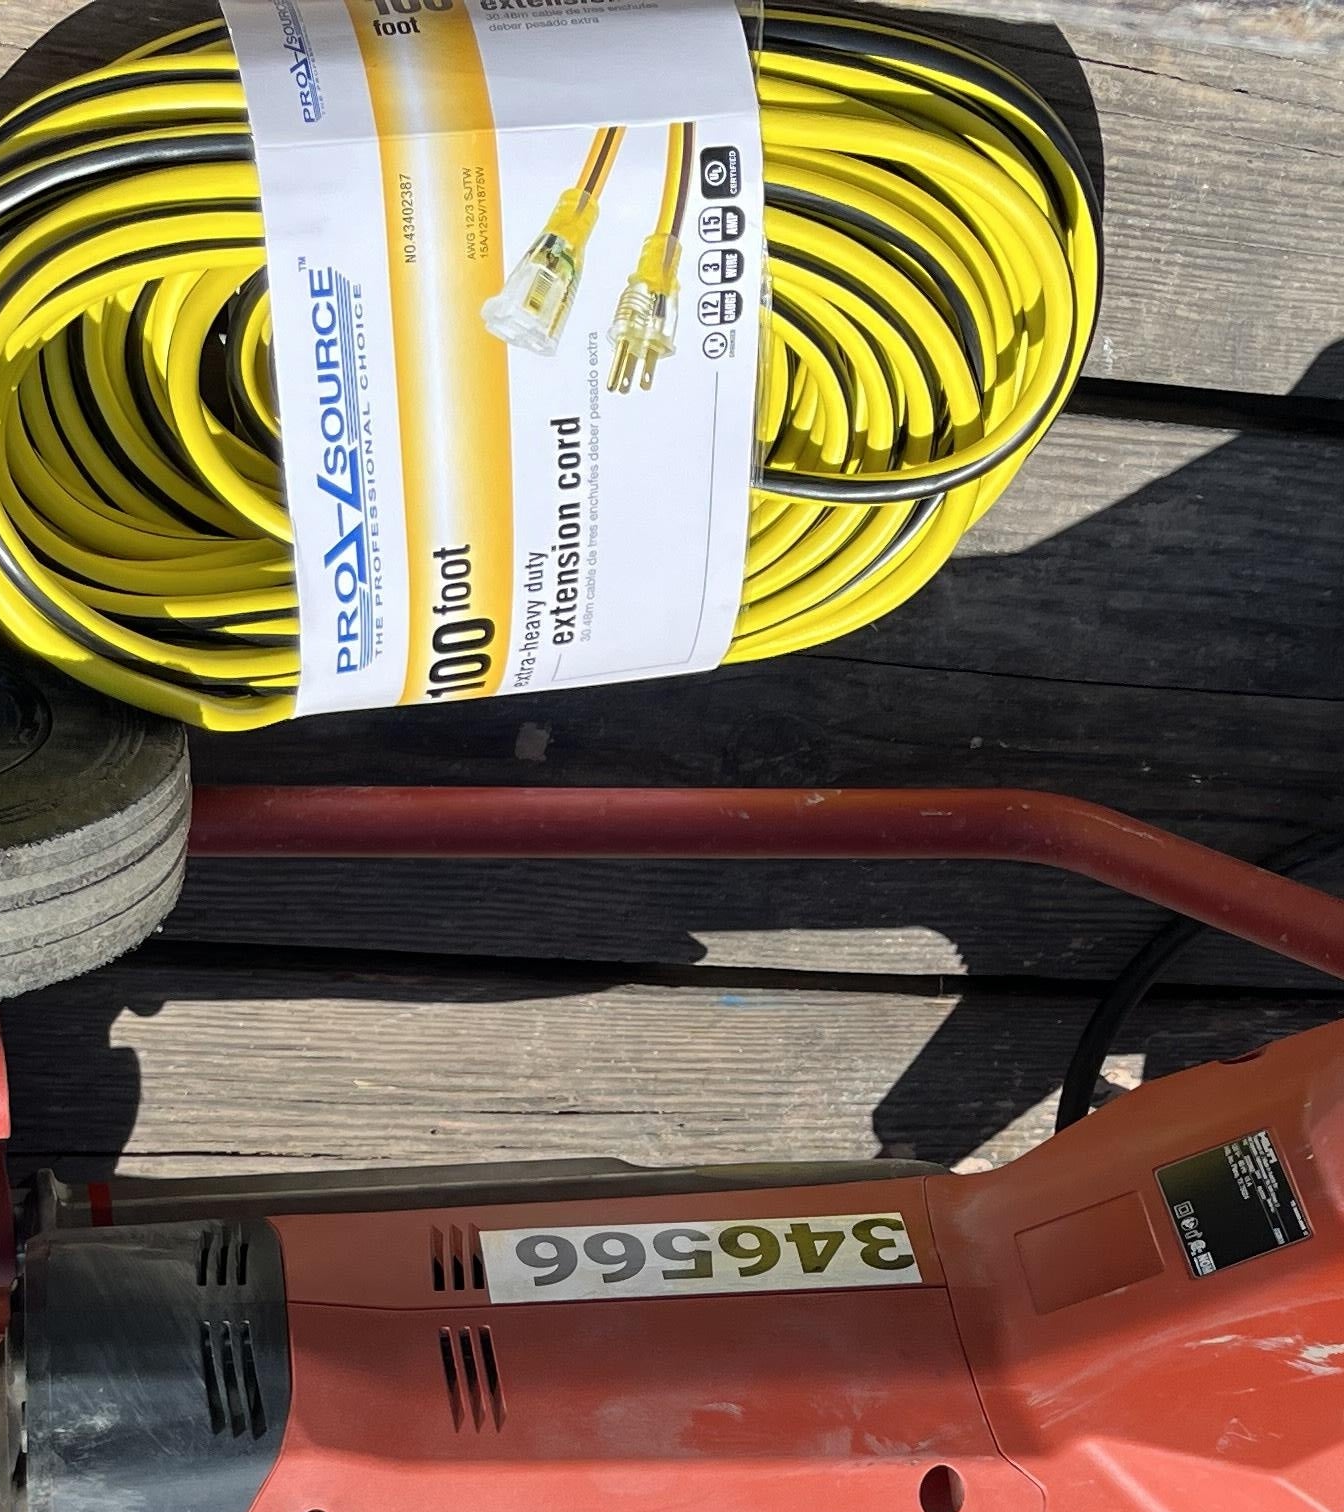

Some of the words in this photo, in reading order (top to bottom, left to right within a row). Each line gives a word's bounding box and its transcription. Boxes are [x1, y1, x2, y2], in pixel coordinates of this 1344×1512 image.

[373, 16, 421, 37] foot
[488, 22, 522, 32] deber
[525, 19, 568, 30] pesado
[570, 16, 600, 26] extra
[462, 167, 474, 200] SJTW
[399, 173, 417, 264] NO.43402387
[464, 204, 476, 228] 12/3
[702, 215, 721, 236] 15
[726, 212, 739, 236] AMP
[465, 232, 477, 261] AWG
[702, 262, 721, 273] 3
[725, 252, 739, 279] WIRE
[701, 299, 720, 319] 12
[724, 291, 737, 322] GAUGE
[352, 282, 369, 391] CHOICE
[585, 331, 599, 367] extra
[585, 369, 601, 420] pesado
[550, 415, 581, 490] cord
[585, 422, 600, 461] deber
[362, 402, 383, 607] PROFESSIONAL
[586, 463, 600, 522] enchufes
[586, 524, 599, 548] tres
[522, 551, 549, 595] duty
[550, 500, 582, 646] extension
[585, 550, 598, 567] de
[432, 543, 472, 616] foot
[583, 568, 599, 601] cable
[374, 615, 384, 656] THE
[580, 602, 597, 642] 30.48m
[425, 617, 496, 700] 100
[514, 599, 544, 689] extra-heavy
[514, 1216, 916, 1288] 346566
